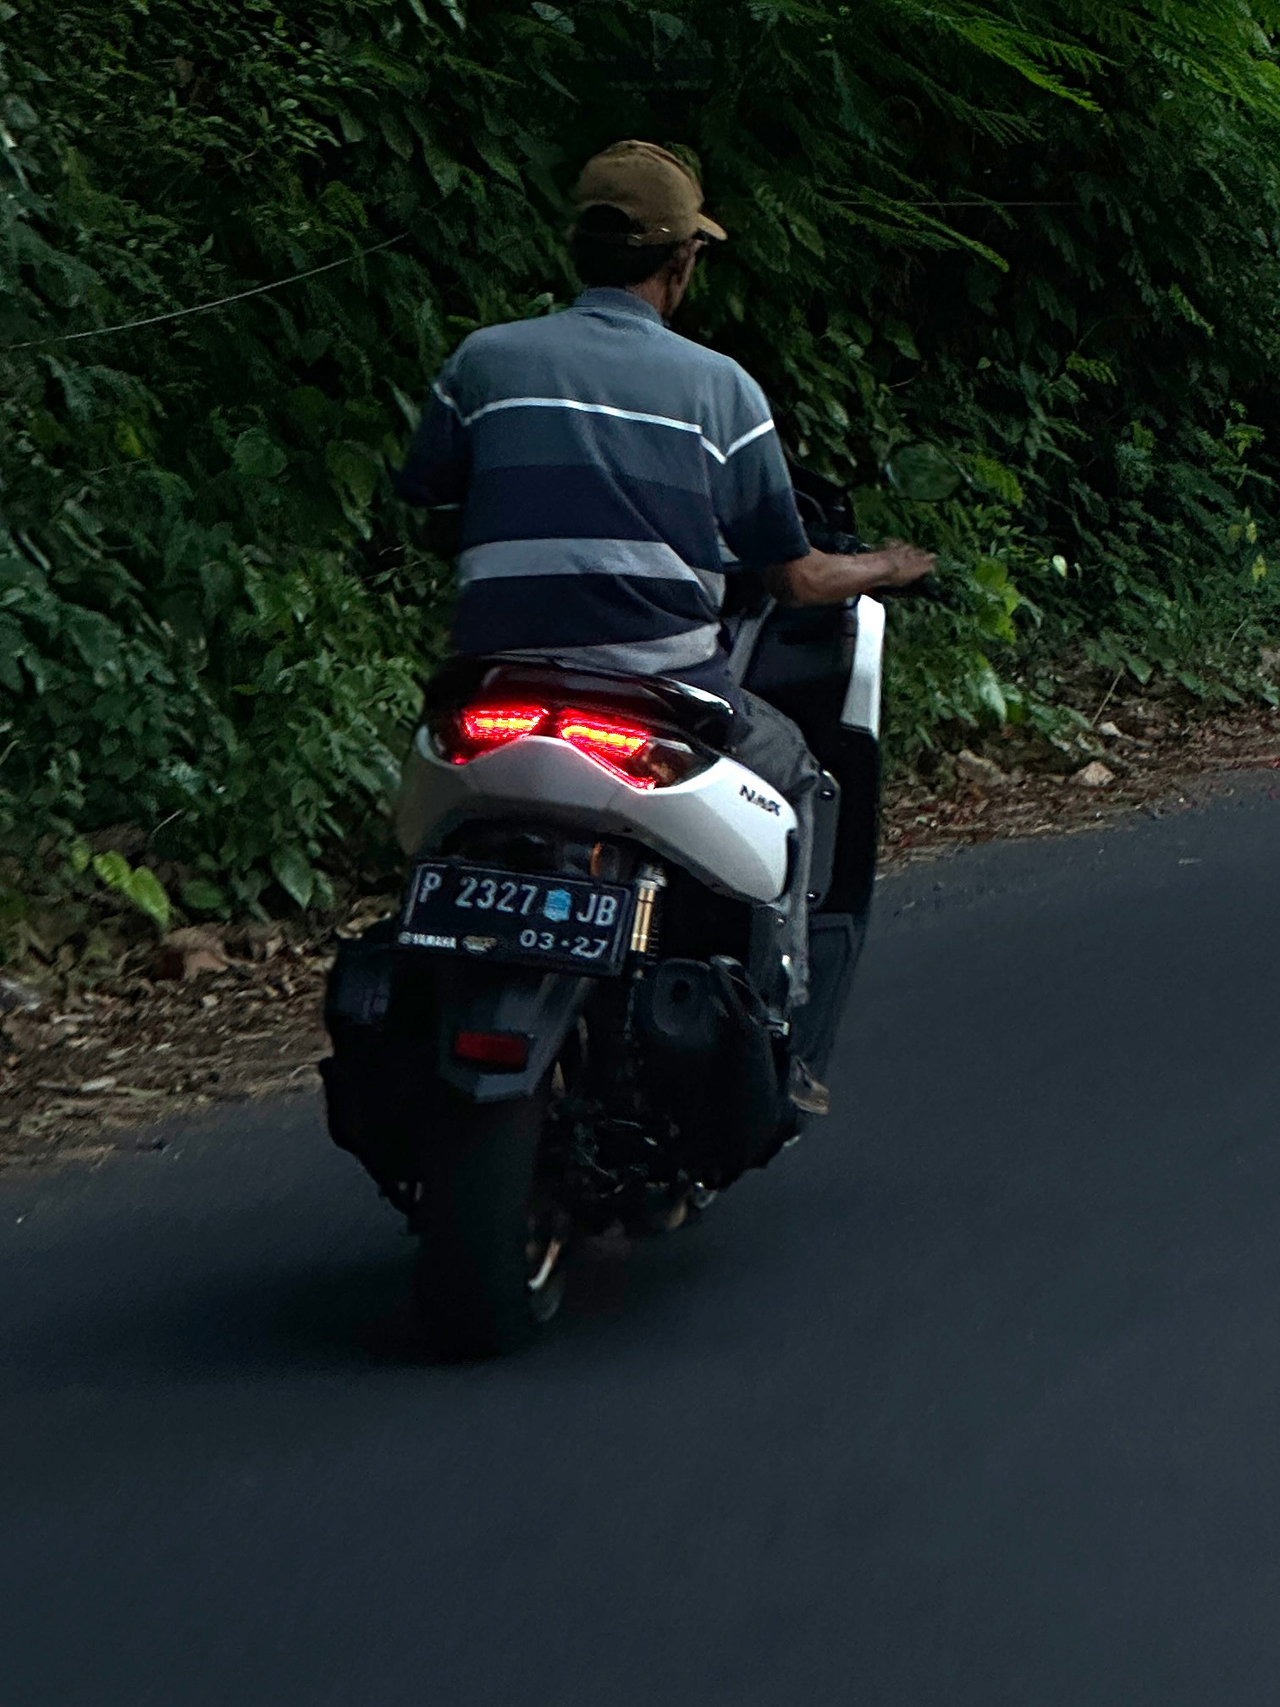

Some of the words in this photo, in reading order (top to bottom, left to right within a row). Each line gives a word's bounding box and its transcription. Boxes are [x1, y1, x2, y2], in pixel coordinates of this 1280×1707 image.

[418, 872, 442, 904] P
[455, 876, 539, 916] 2327
[576, 893, 619, 927] JB
